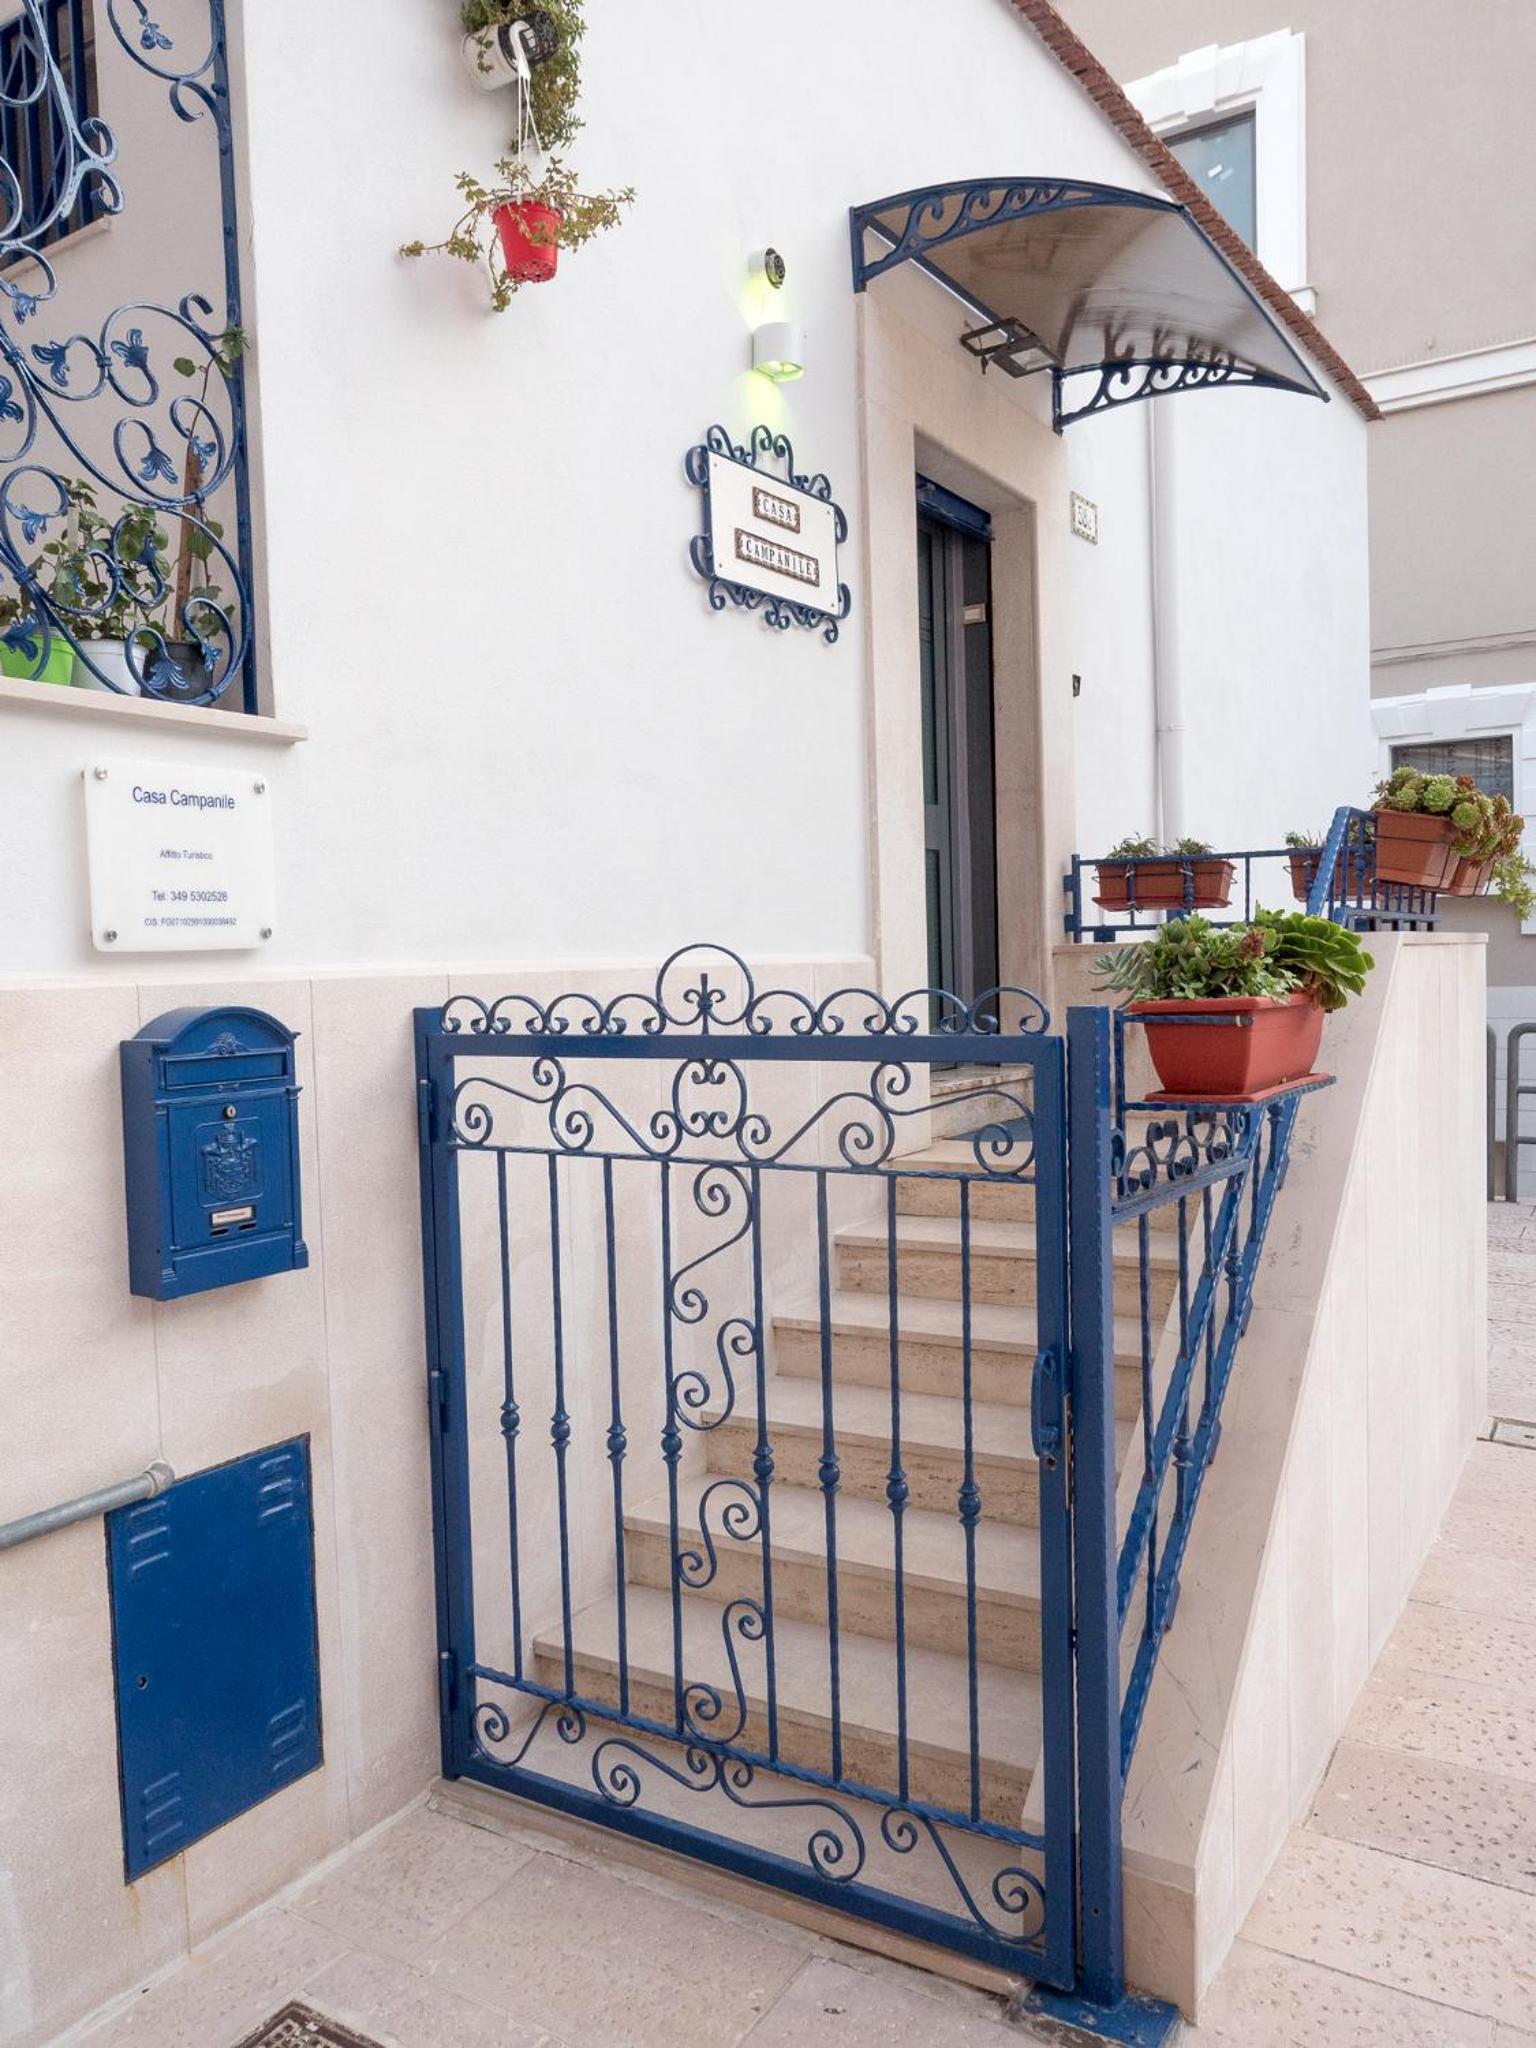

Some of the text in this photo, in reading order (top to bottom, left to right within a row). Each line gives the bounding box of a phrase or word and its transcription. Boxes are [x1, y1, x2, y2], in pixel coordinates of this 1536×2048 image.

[763, 498, 792, 522] CASA
[746, 539, 812, 576] CAMPANILE
[132, 786, 235, 811] Casa Campanile
[170, 890, 188, 902] 349
[190, 890, 228, 902] 5302528
